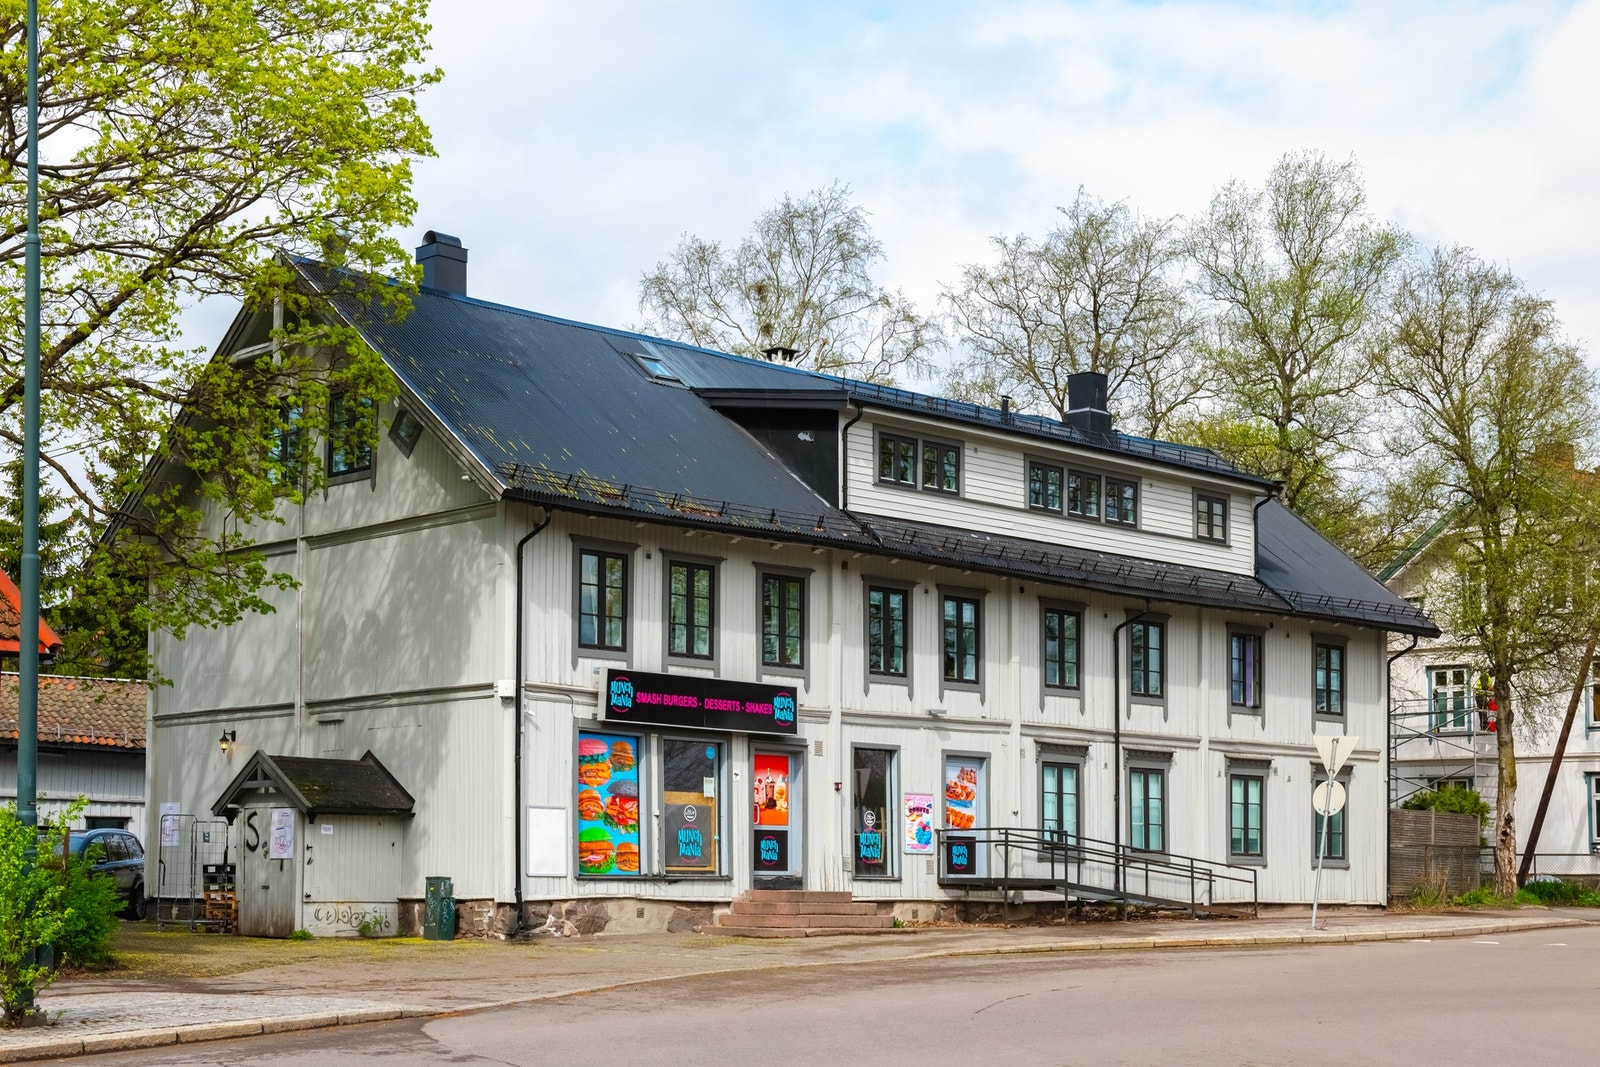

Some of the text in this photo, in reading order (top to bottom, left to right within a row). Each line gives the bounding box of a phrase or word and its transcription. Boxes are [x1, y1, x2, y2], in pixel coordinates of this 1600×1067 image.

[636, 691, 662, 705] SMASH
[663, 694, 698, 708] BURGERS
[704, 698, 741, 712] DESSERTS
[745, 701, 773, 715] SHAKES
